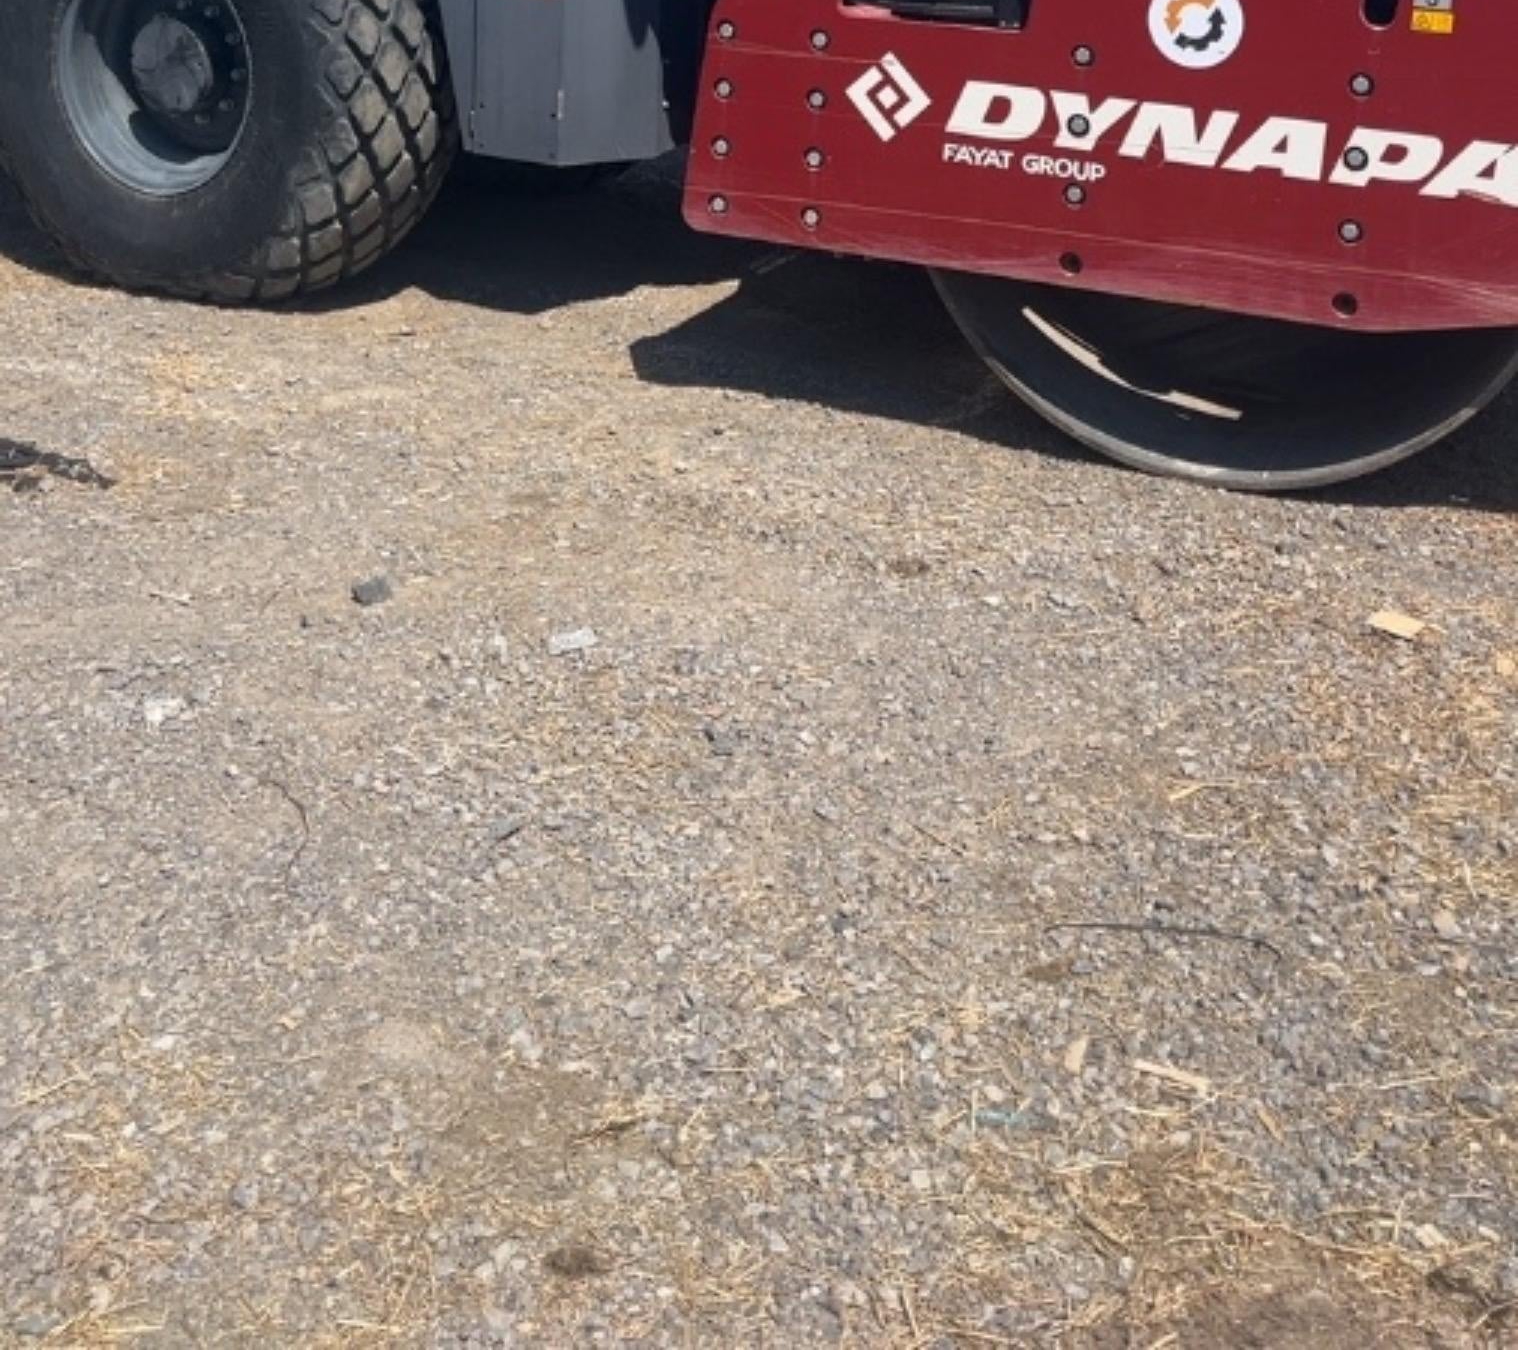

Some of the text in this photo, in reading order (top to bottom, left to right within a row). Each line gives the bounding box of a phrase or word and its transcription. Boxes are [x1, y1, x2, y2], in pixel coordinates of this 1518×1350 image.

[942, 143, 1107, 182] FAYAT GROUP
[944, 79, 1518, 207] DYNAPA
